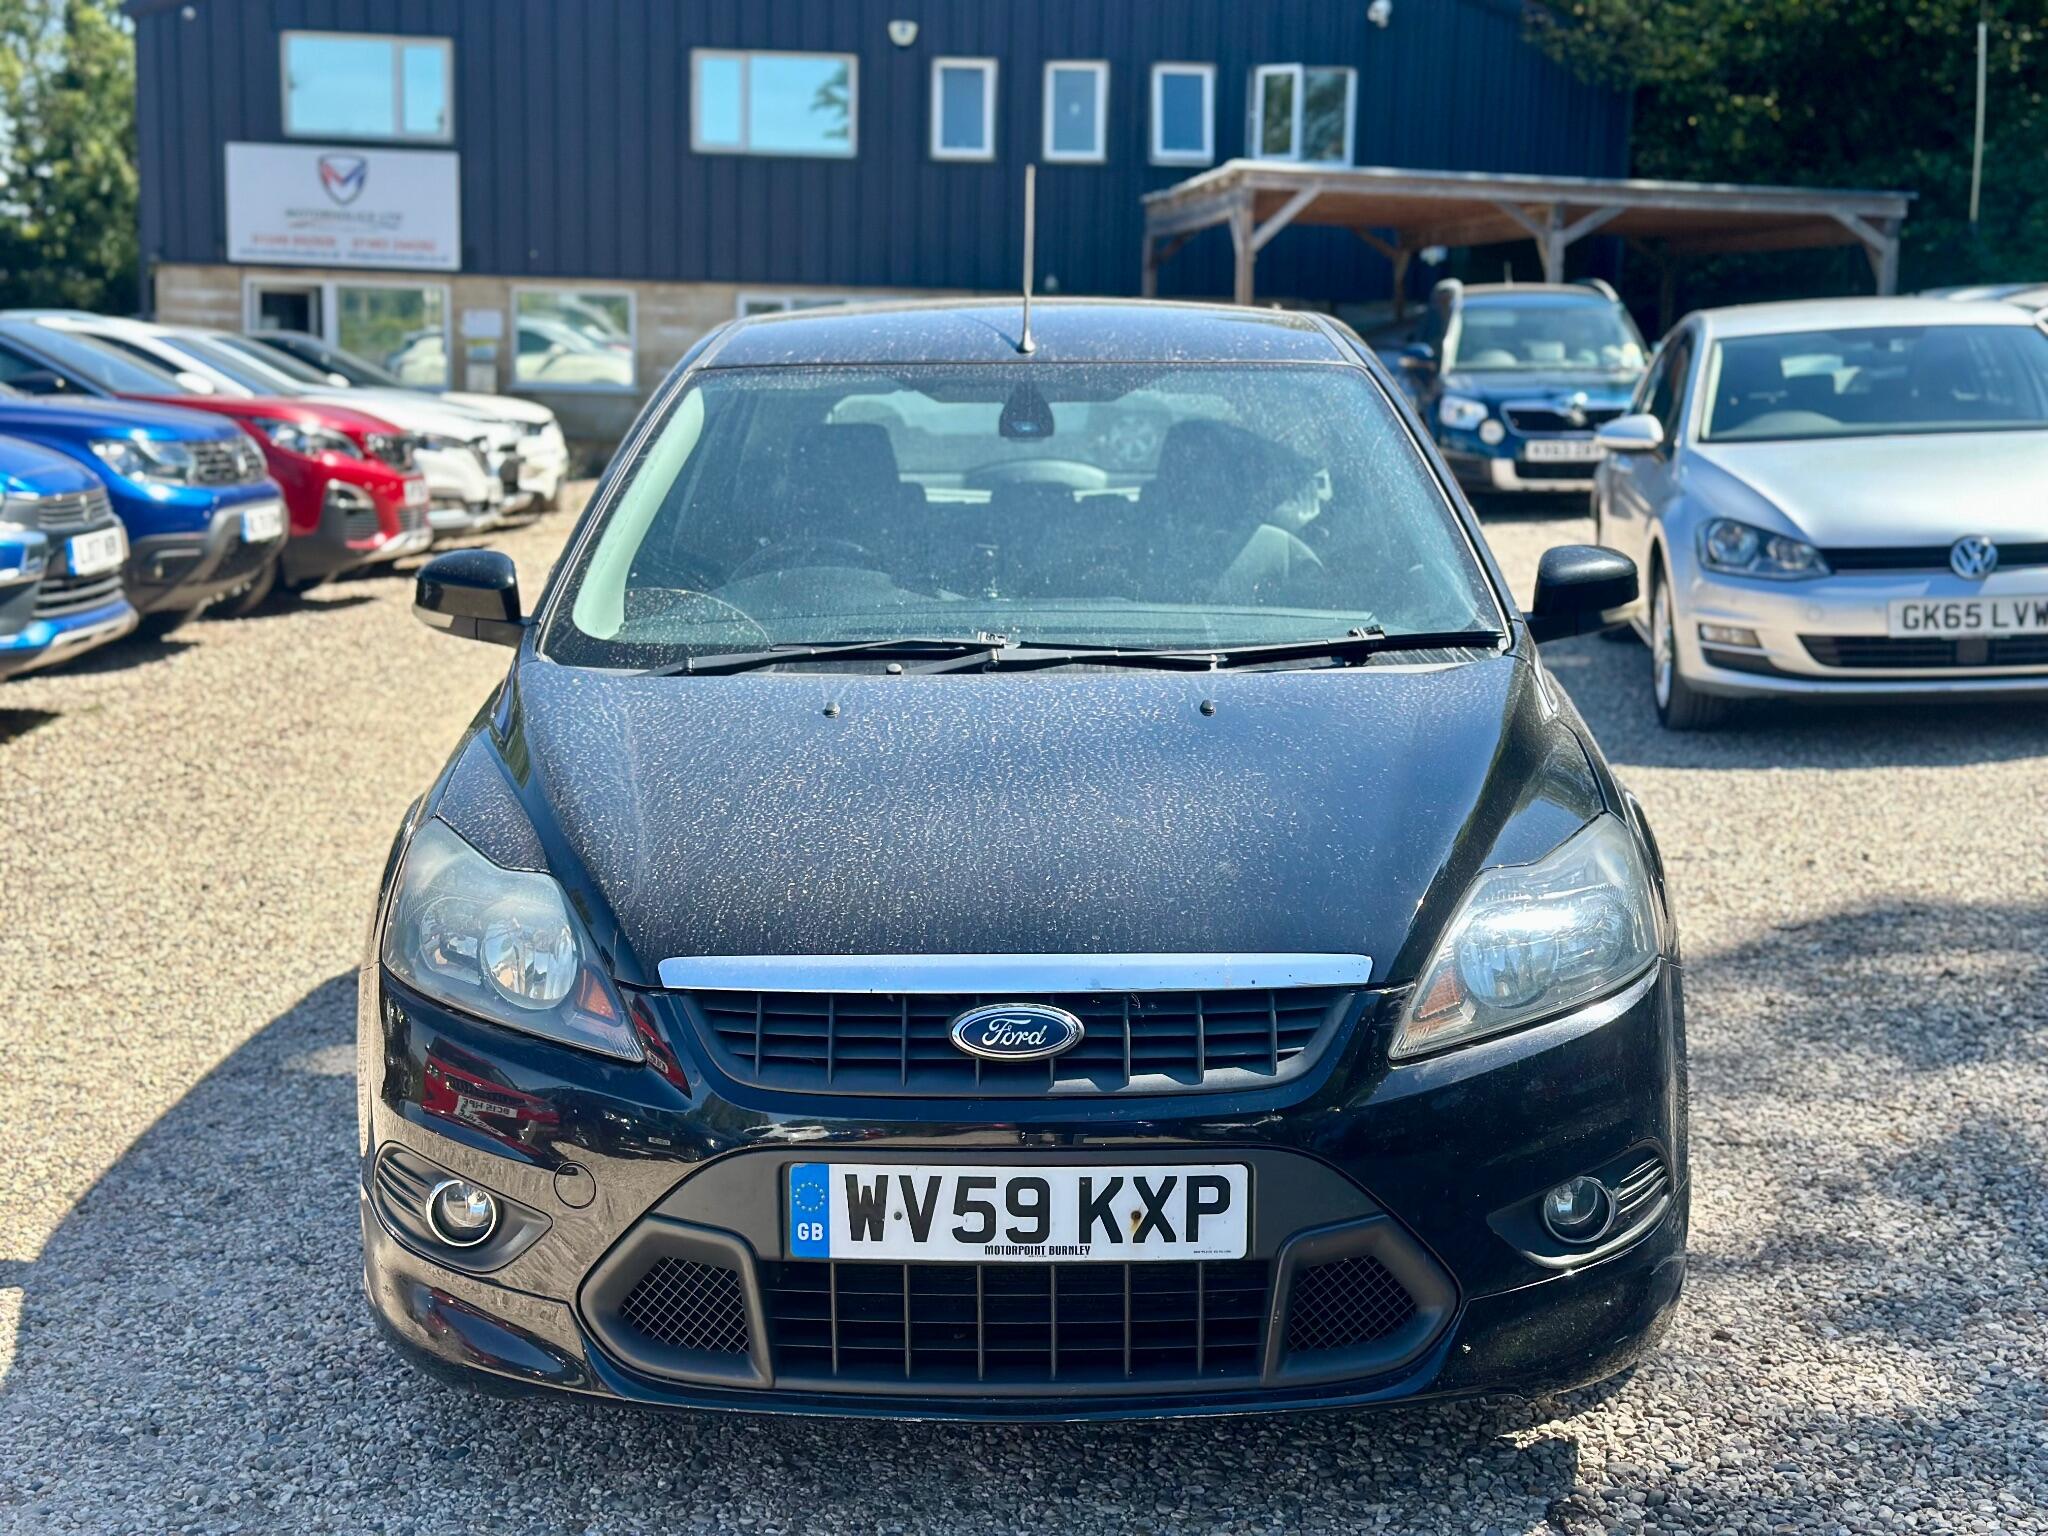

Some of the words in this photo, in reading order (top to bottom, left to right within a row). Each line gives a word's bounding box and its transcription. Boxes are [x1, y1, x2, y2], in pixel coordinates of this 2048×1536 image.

[1902, 603, 1983, 631] GK65
[1991, 601, 2048, 628] LVW
[981, 1018, 1048, 1046] Ford
[844, 1174, 1051, 1244] WV59
[1078, 1175, 1231, 1244] KXP
[797, 1222, 824, 1241] GB
[984, 1245, 1046, 1256] MOTORPOINT
[1048, 1245, 1091, 1256] BURNLEY
